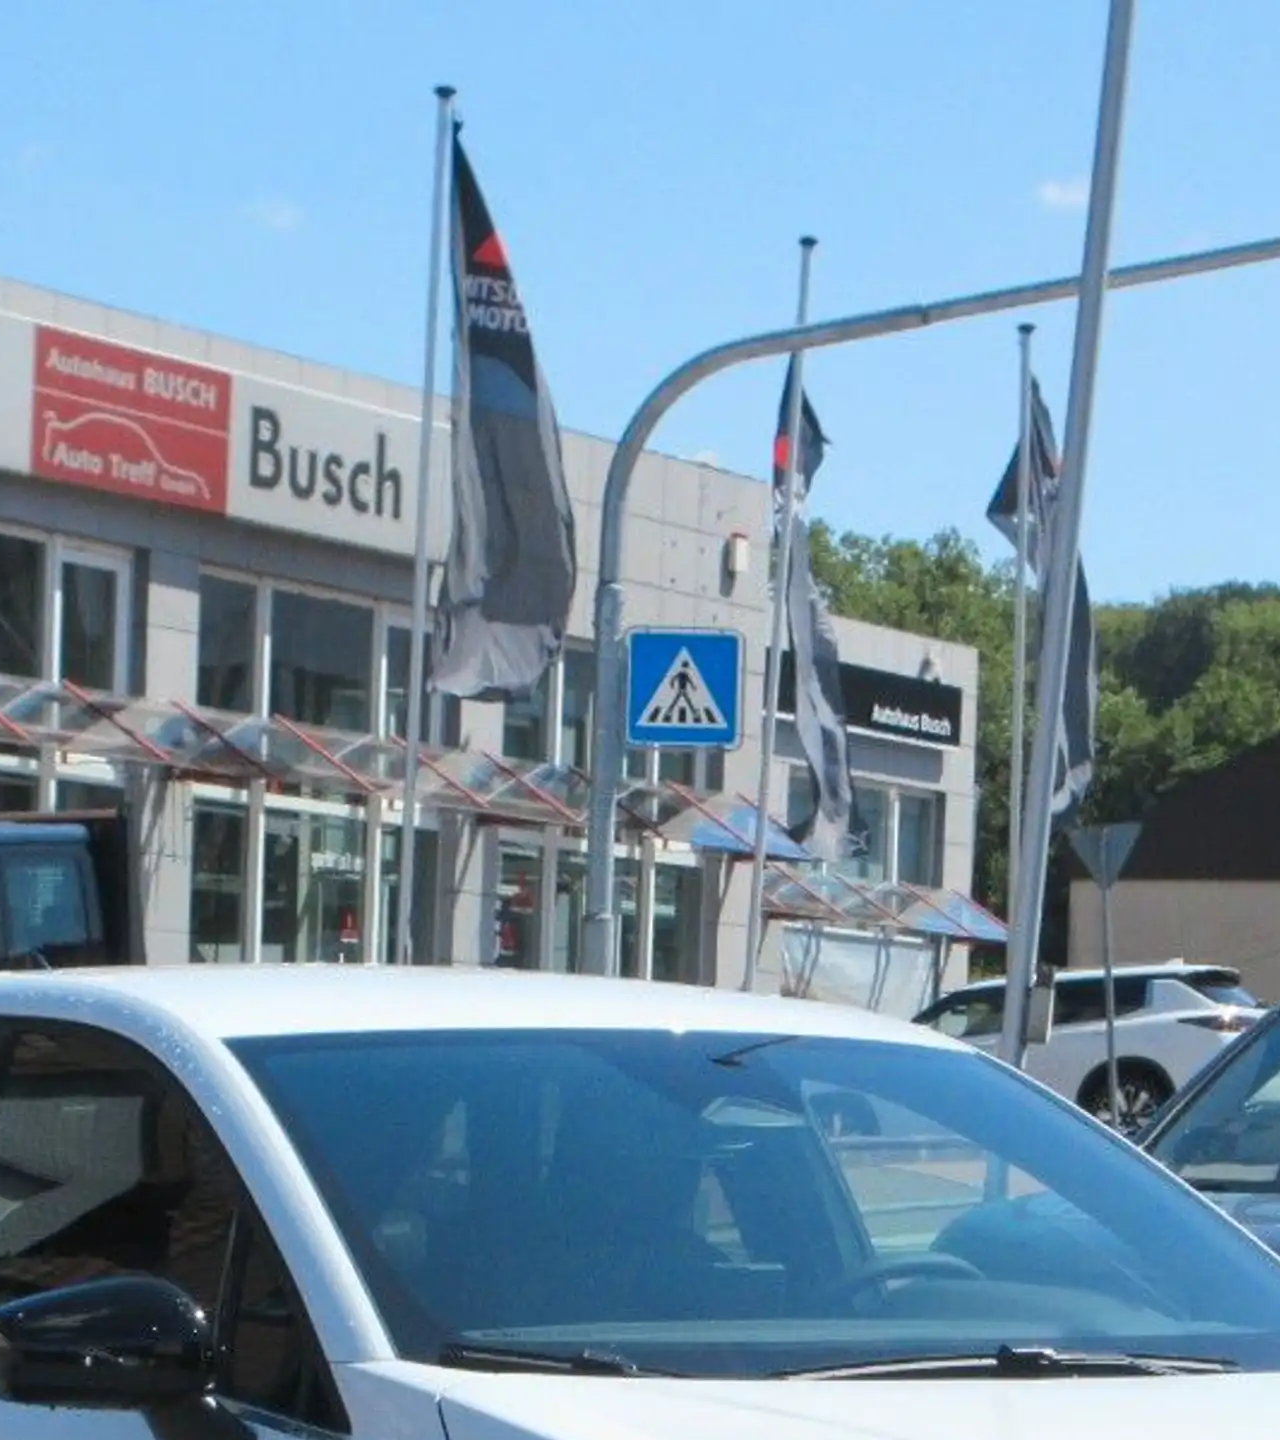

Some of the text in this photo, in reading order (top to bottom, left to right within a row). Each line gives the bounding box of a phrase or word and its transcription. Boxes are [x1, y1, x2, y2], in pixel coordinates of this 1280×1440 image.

[44, 347, 217, 412] Autohaus BUSCH
[52, 441, 104, 476] Auto
[108, 452, 157, 487] Treff
[248, 403, 403, 521] Busch
